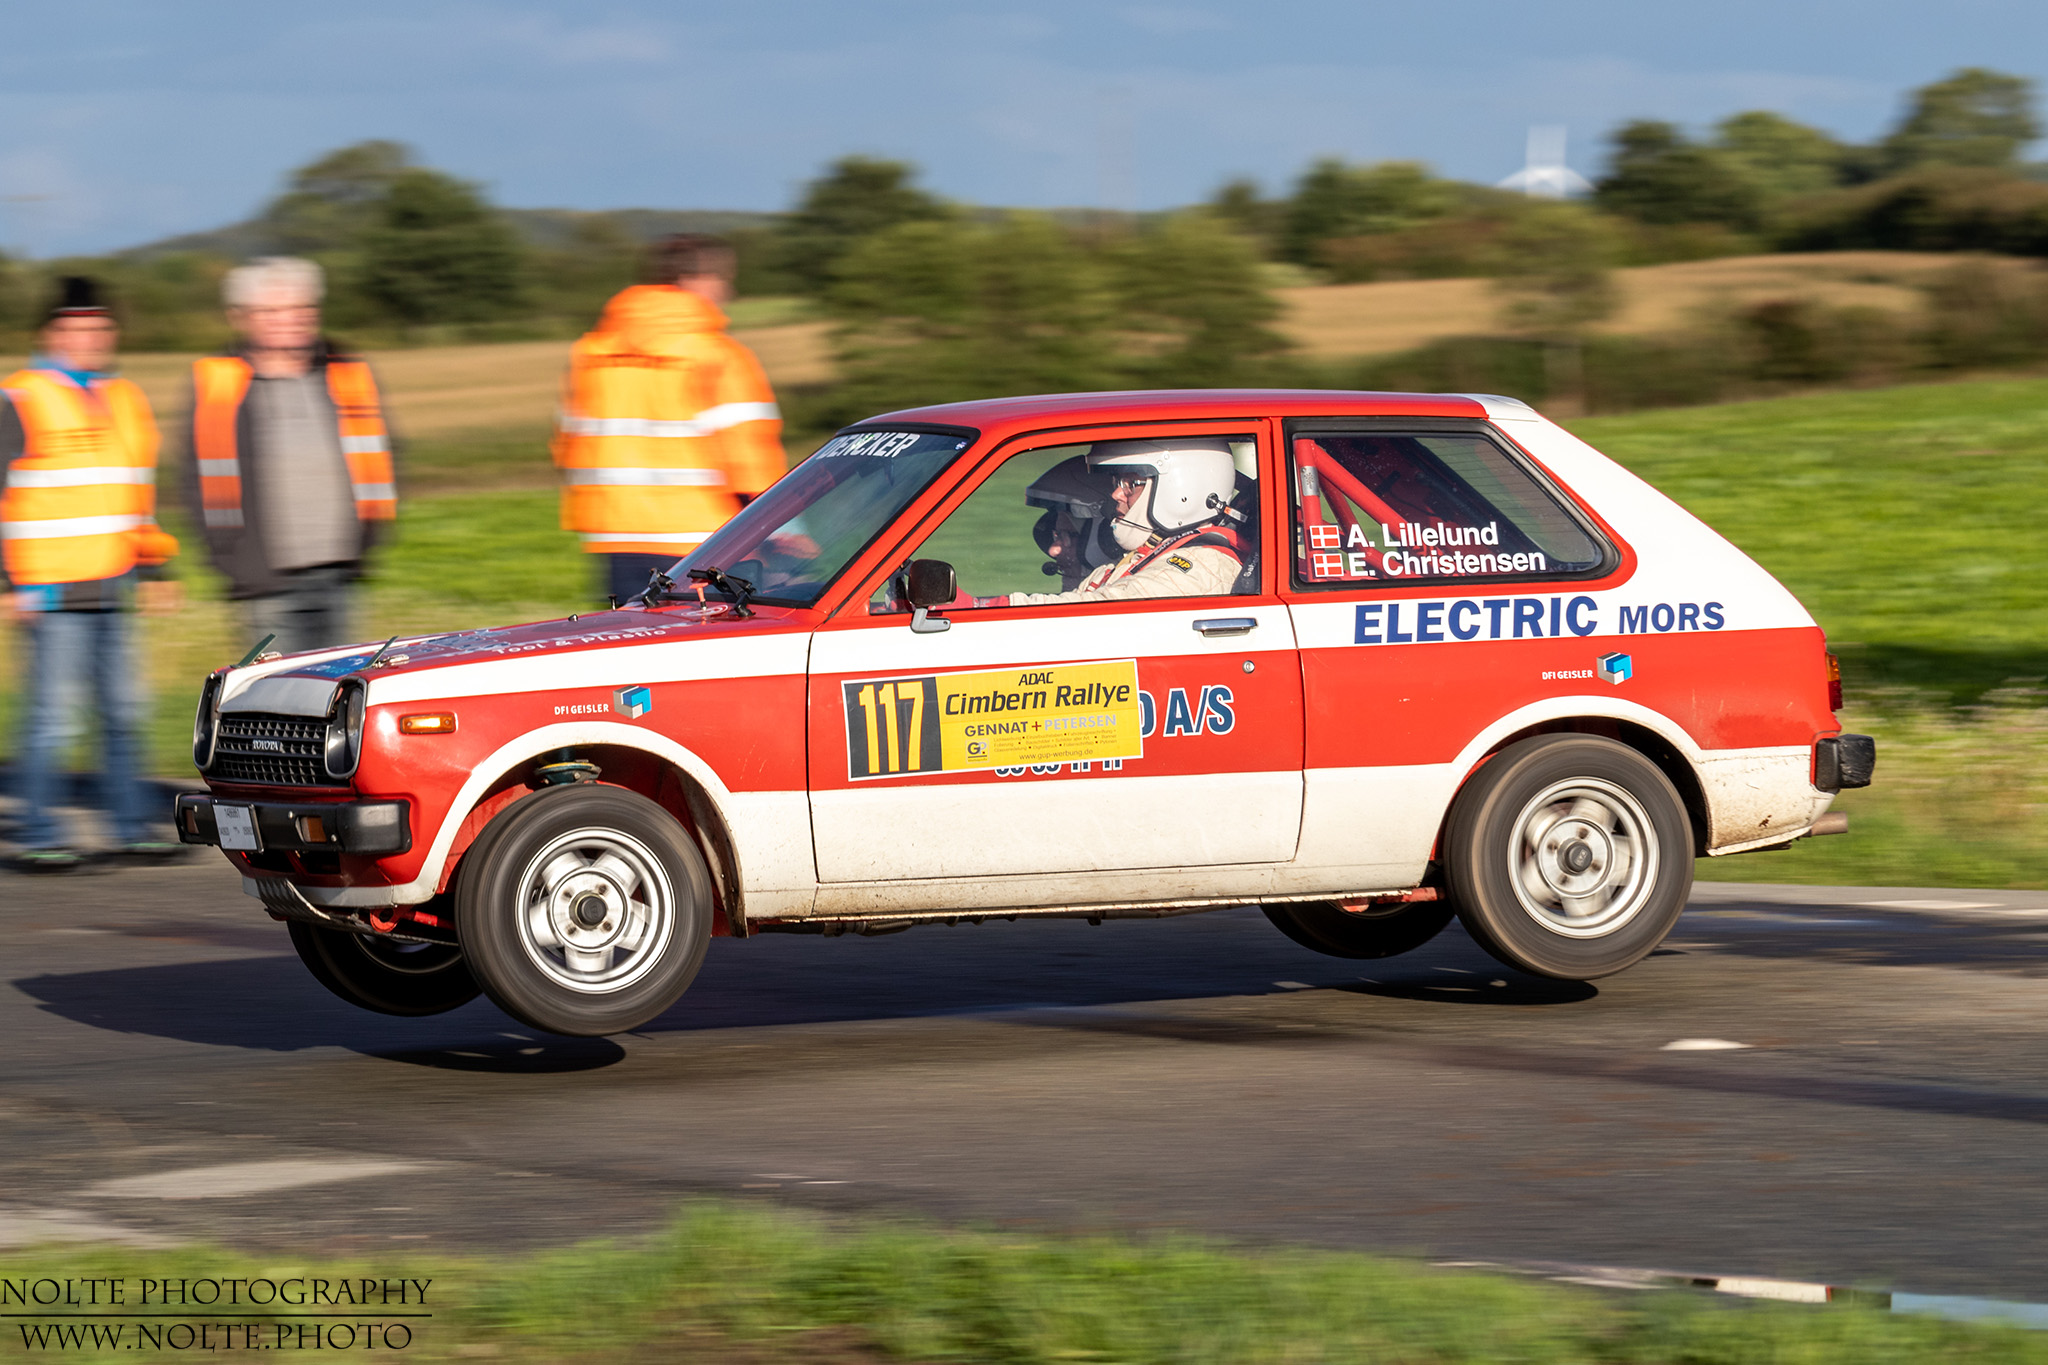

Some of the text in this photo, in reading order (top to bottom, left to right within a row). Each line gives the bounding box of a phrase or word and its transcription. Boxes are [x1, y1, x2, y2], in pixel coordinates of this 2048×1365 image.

[1347, 521, 1499, 548] A. Lillelund
[1348, 550, 1546, 577] E. Christensen
[1354, 595, 1725, 645] ELECTRIC MORS
[1018, 672, 1054, 686] ADAC
[1542, 669, 1593, 680] DFI GEISLER
[554, 703, 609, 715] DFI GEISLER
[945, 682, 1130, 716] Cimbern Rallye
[1163, 685, 1235, 737] A/S
[858, 681, 924, 774] 117
[965, 721, 1029, 737] GENNAT
[1044, 714, 1117, 731] PETERSEN
[252, 739, 279, 750] TOYOTA
[1019, 749, 1093, 760] www.gup-werbung.de
